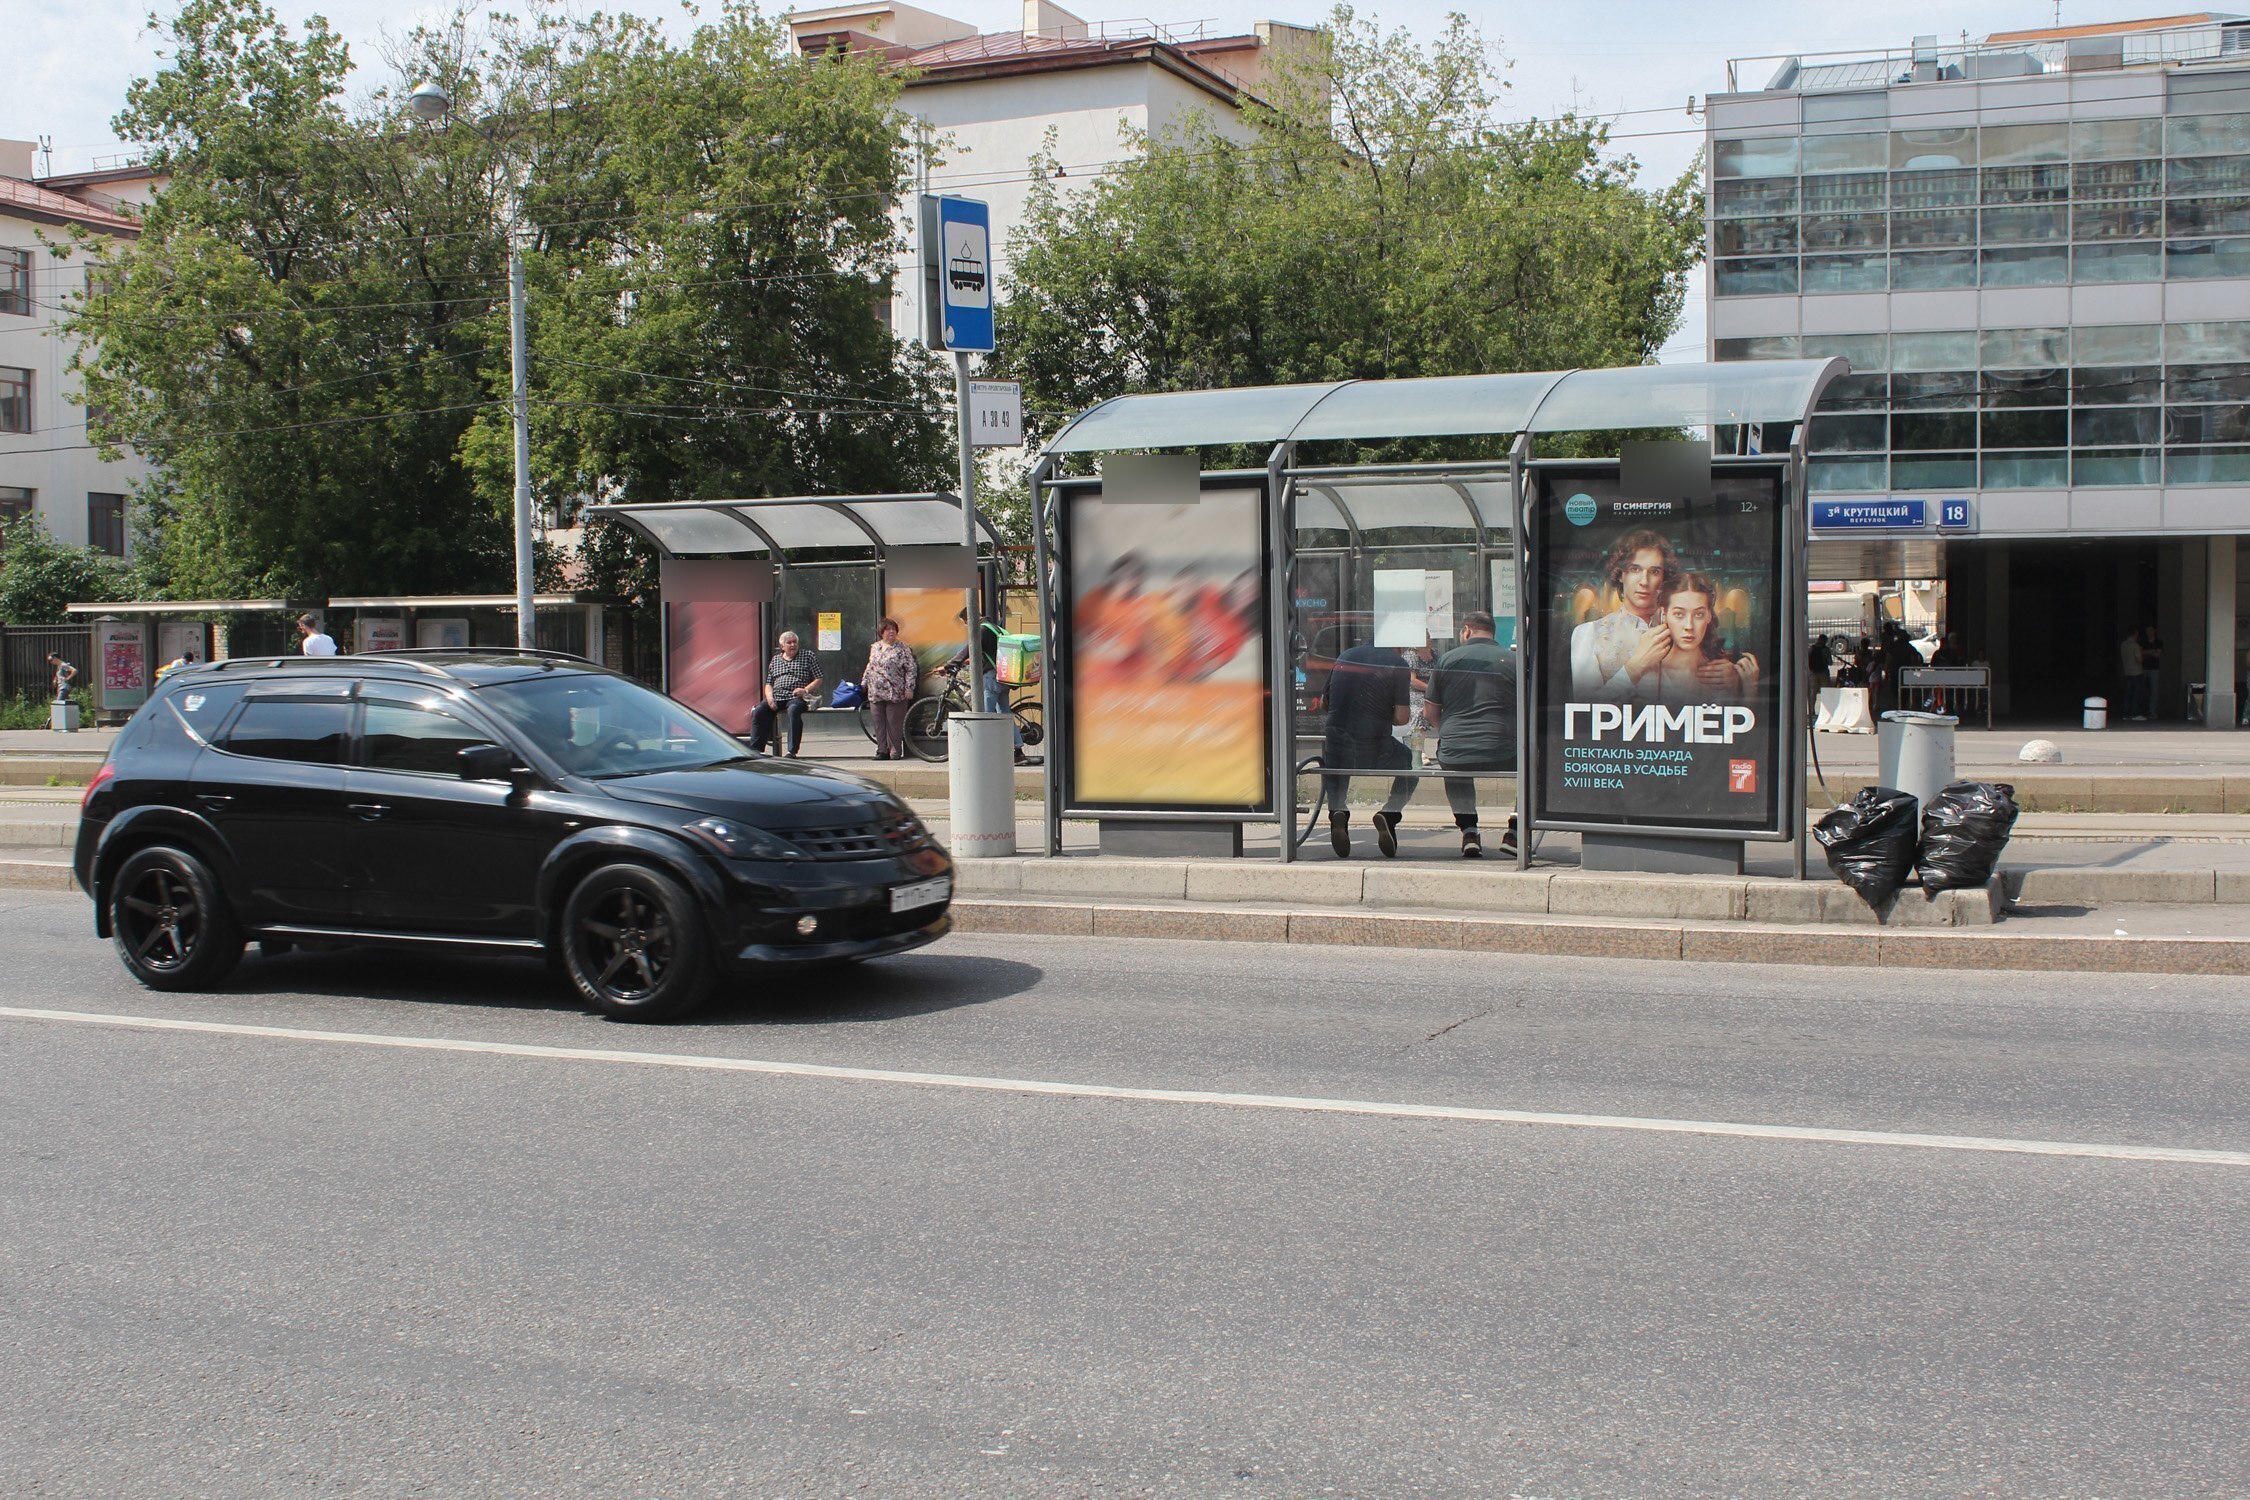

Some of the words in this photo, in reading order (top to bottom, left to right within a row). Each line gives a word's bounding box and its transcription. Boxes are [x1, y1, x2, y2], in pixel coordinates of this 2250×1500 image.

[1002, 410, 1010, 428] 43
[1622, 502, 1672, 511] СИНЕРГИЯ
[1740, 502, 1758, 513] 12+
[1843, 505, 1909, 518] КРУТИЦКИЙ
[1946, 506, 1964, 521] 18
[1295, 599, 1327, 608] КУСНО
[1564, 703, 1756, 744] ГРИМЁР
[1564, 747, 1634, 760] СПЕКТАКЛЬ
[1636, 750, 1693, 762] ЭДУАРДА
[1564, 763, 1622, 775] БОЯКОВА
[1624, 765, 1631, 774] В
[1633, 765, 1688, 777] УСАДЬБЕ
[1564, 777, 1591, 788] XVIII
[1593, 778, 1624, 789] ВЕКА
[1731, 769, 1753, 790] 7
